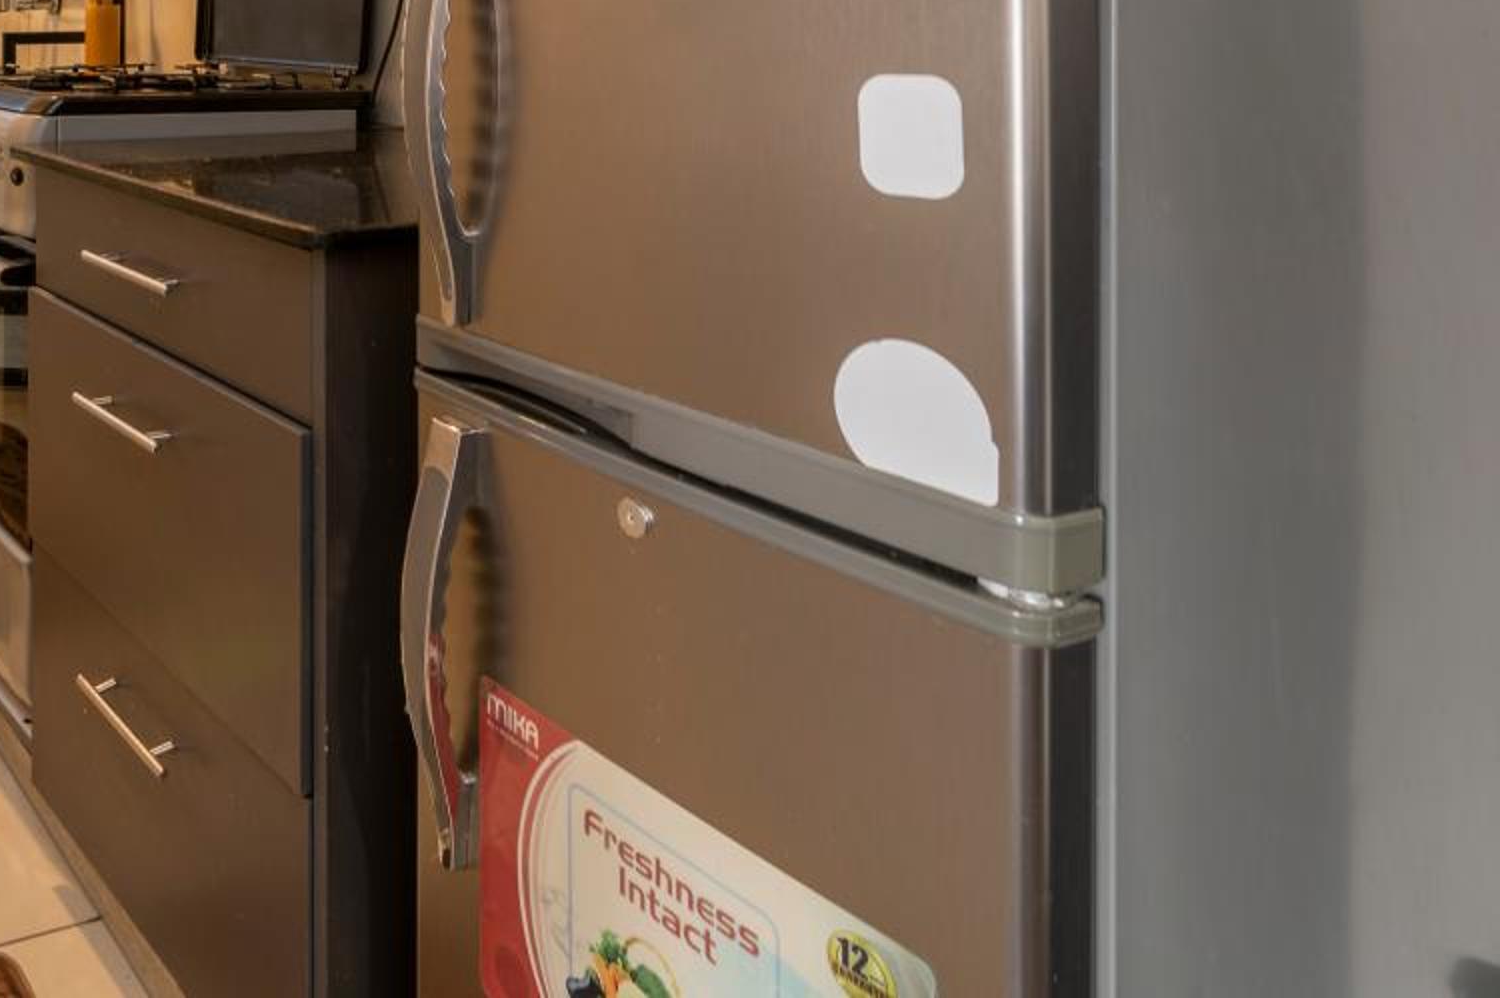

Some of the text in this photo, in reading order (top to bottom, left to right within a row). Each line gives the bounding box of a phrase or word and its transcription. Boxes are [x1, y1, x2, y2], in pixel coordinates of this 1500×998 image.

[486, 692, 539, 751] MIKA
[583, 809, 760, 957] Freshness
[618, 865, 718, 967] Intact
[836, 937, 869, 981] 12
